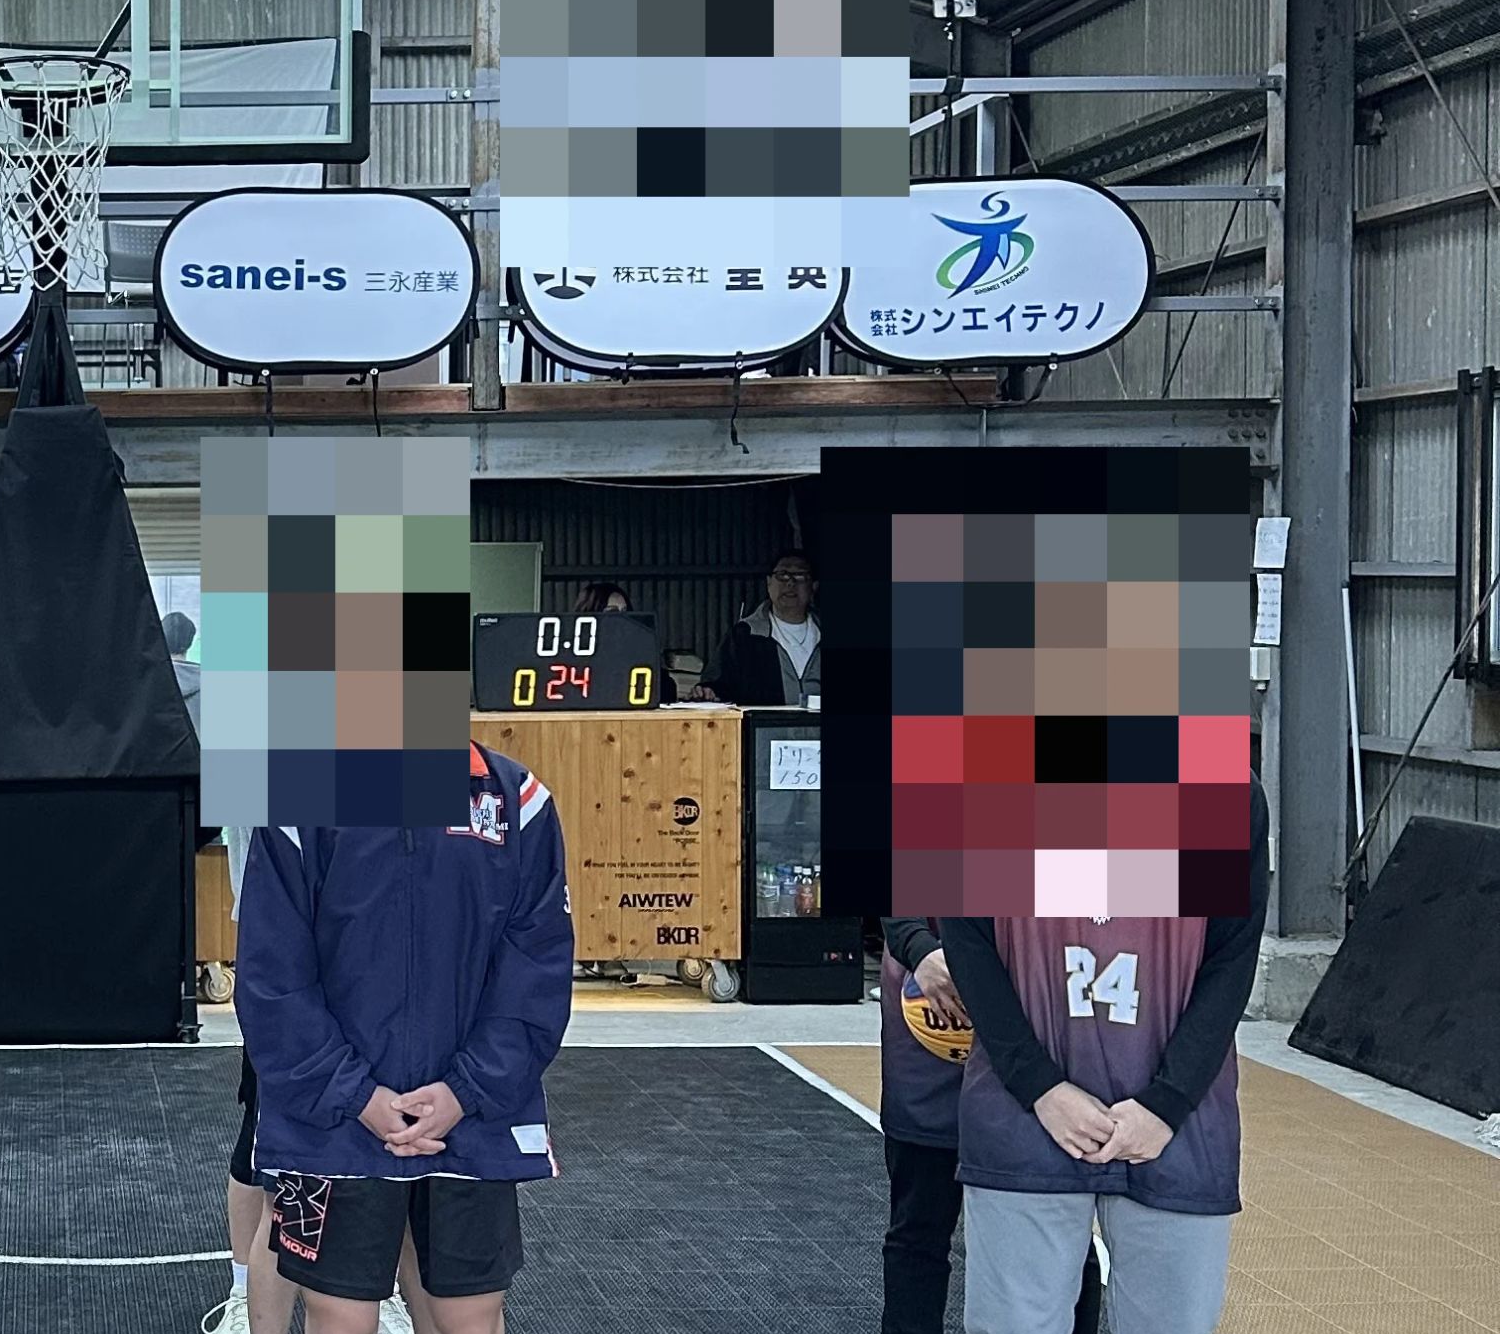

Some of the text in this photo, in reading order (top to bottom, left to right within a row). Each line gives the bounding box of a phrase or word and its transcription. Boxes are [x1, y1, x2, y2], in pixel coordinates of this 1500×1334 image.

[180, 259, 459, 292] sanei-s 三永産業
[613, 267, 709, 283] 株式会社
[901, 301, 1104, 335] シンエイテクノ
[537, 617, 597, 657] 0.0
[513, 665, 652, 706] 0 24 0
[618, 893, 693, 907] AIWTEW
[657, 927, 699, 944] BKDR
[1064, 946, 1140, 1025] 24
